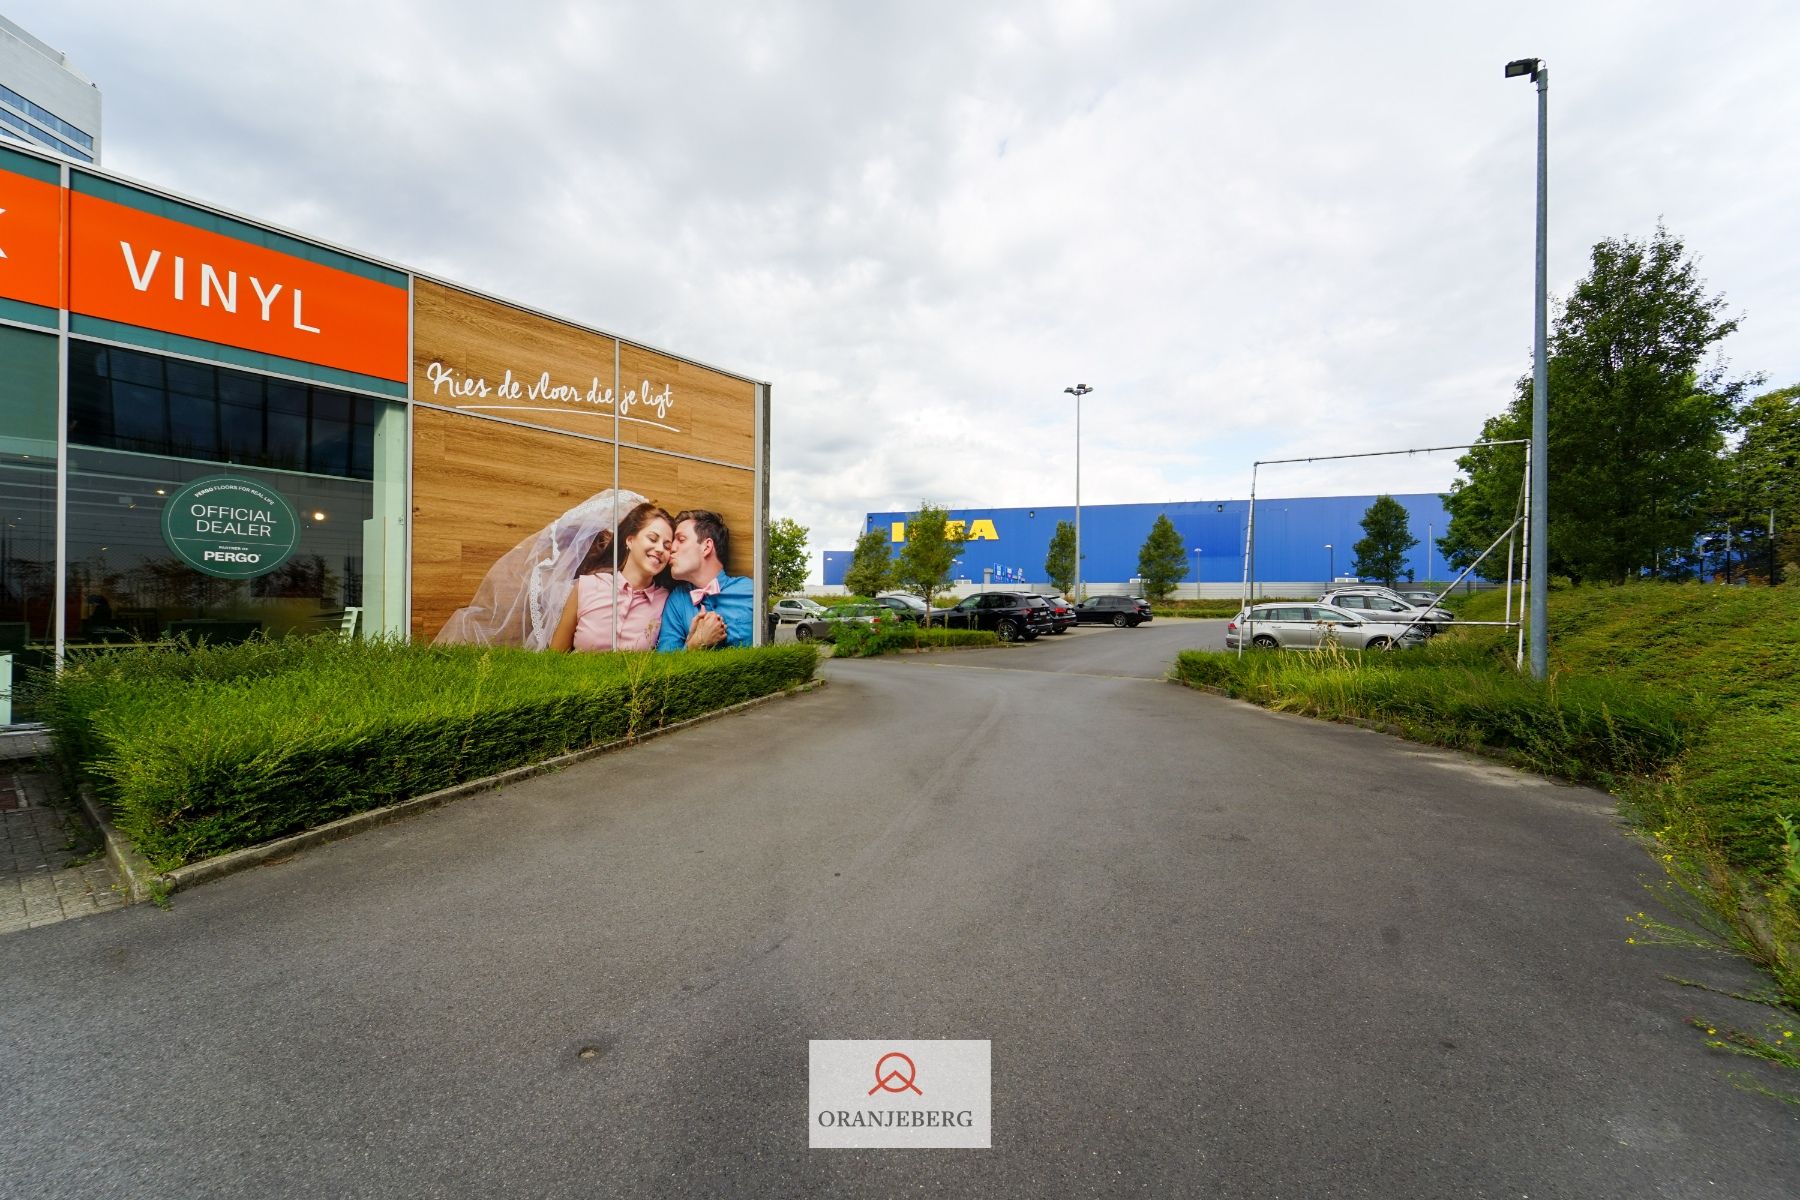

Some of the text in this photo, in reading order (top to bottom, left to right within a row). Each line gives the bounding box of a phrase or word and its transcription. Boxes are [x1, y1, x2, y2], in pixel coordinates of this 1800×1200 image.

[120, 240, 321, 334] VINYL
[427, 362, 673, 418] Kies de vloer die je ligt
[191, 504, 277, 523] OFFICIAL
[196, 519, 271, 537] DEALER
[892, 519, 999, 542] IEA
[204, 551, 260, 563] PERGO
